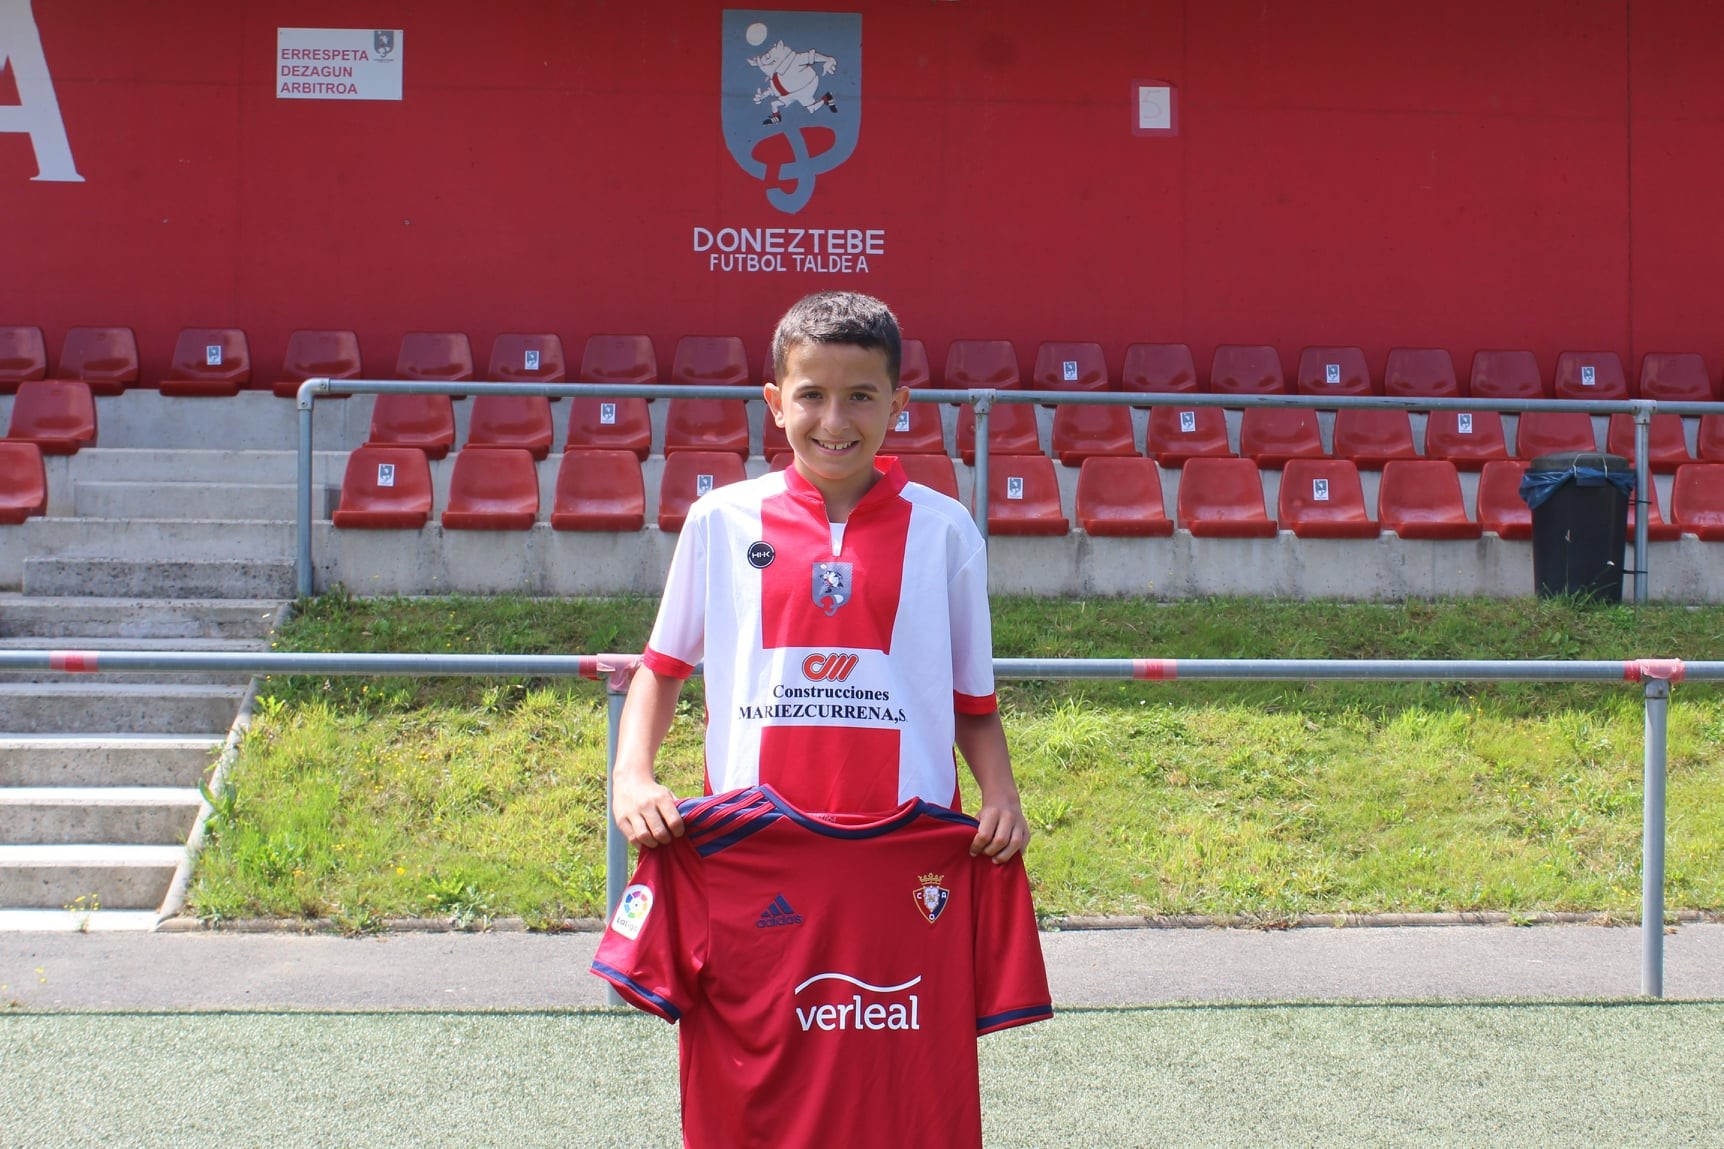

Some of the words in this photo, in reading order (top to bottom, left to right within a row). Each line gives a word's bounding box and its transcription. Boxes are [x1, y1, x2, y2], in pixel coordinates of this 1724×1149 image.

[281, 48, 369, 61] ERRESPETA
[281, 65, 353, 77] DEZAGUN
[280, 82, 358, 94] ARBITROA
[693, 227, 885, 255] DONEZTEBE
[710, 253, 787, 272] FUTBOL
[792, 255, 869, 273] TALDEA
[773, 685, 890, 701] Construcciones
[756, 914, 802, 928] adidas
[796, 994, 920, 1031] verleal
